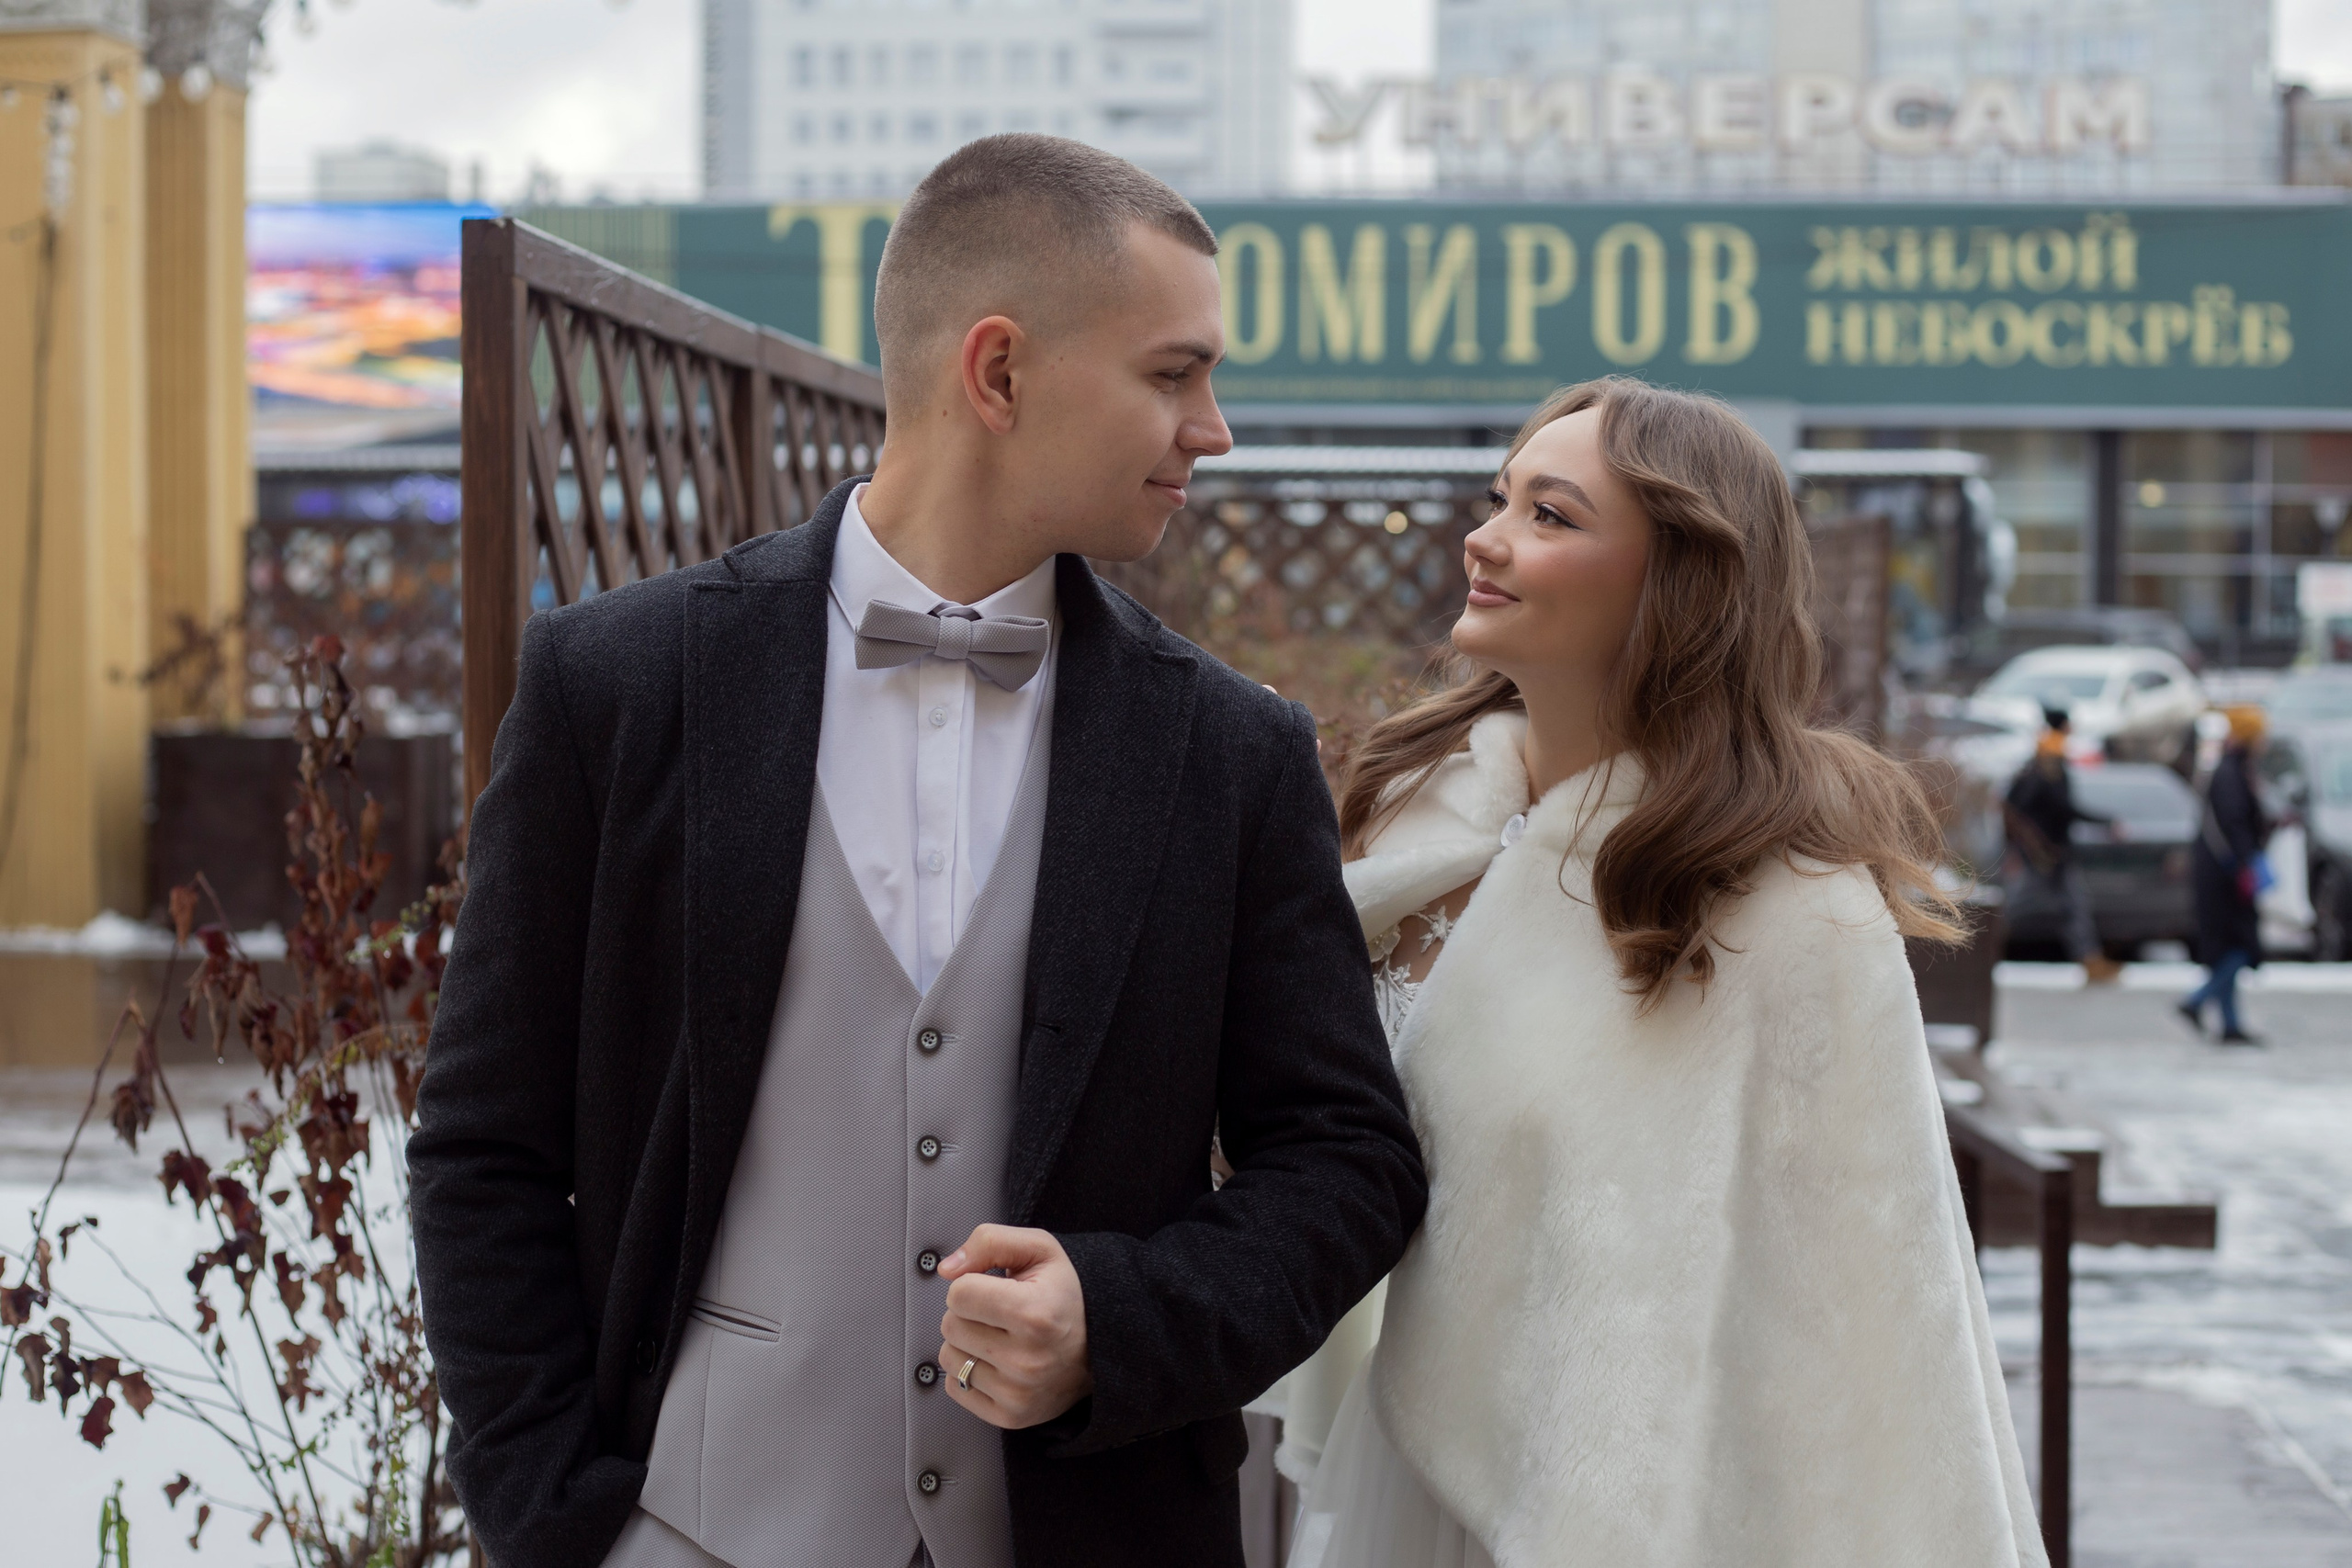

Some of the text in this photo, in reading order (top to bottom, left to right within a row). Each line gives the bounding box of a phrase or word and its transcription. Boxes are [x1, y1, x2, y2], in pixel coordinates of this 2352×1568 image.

[1303, 73, 2153, 156] УНИВЕРСАМ
[768, 202, 1761, 366] ТОМИРОВ
[1805, 210, 2140, 292] ЖИЛОЙ
[1806, 284, 2294, 367] НЕБОСКРЁБ
